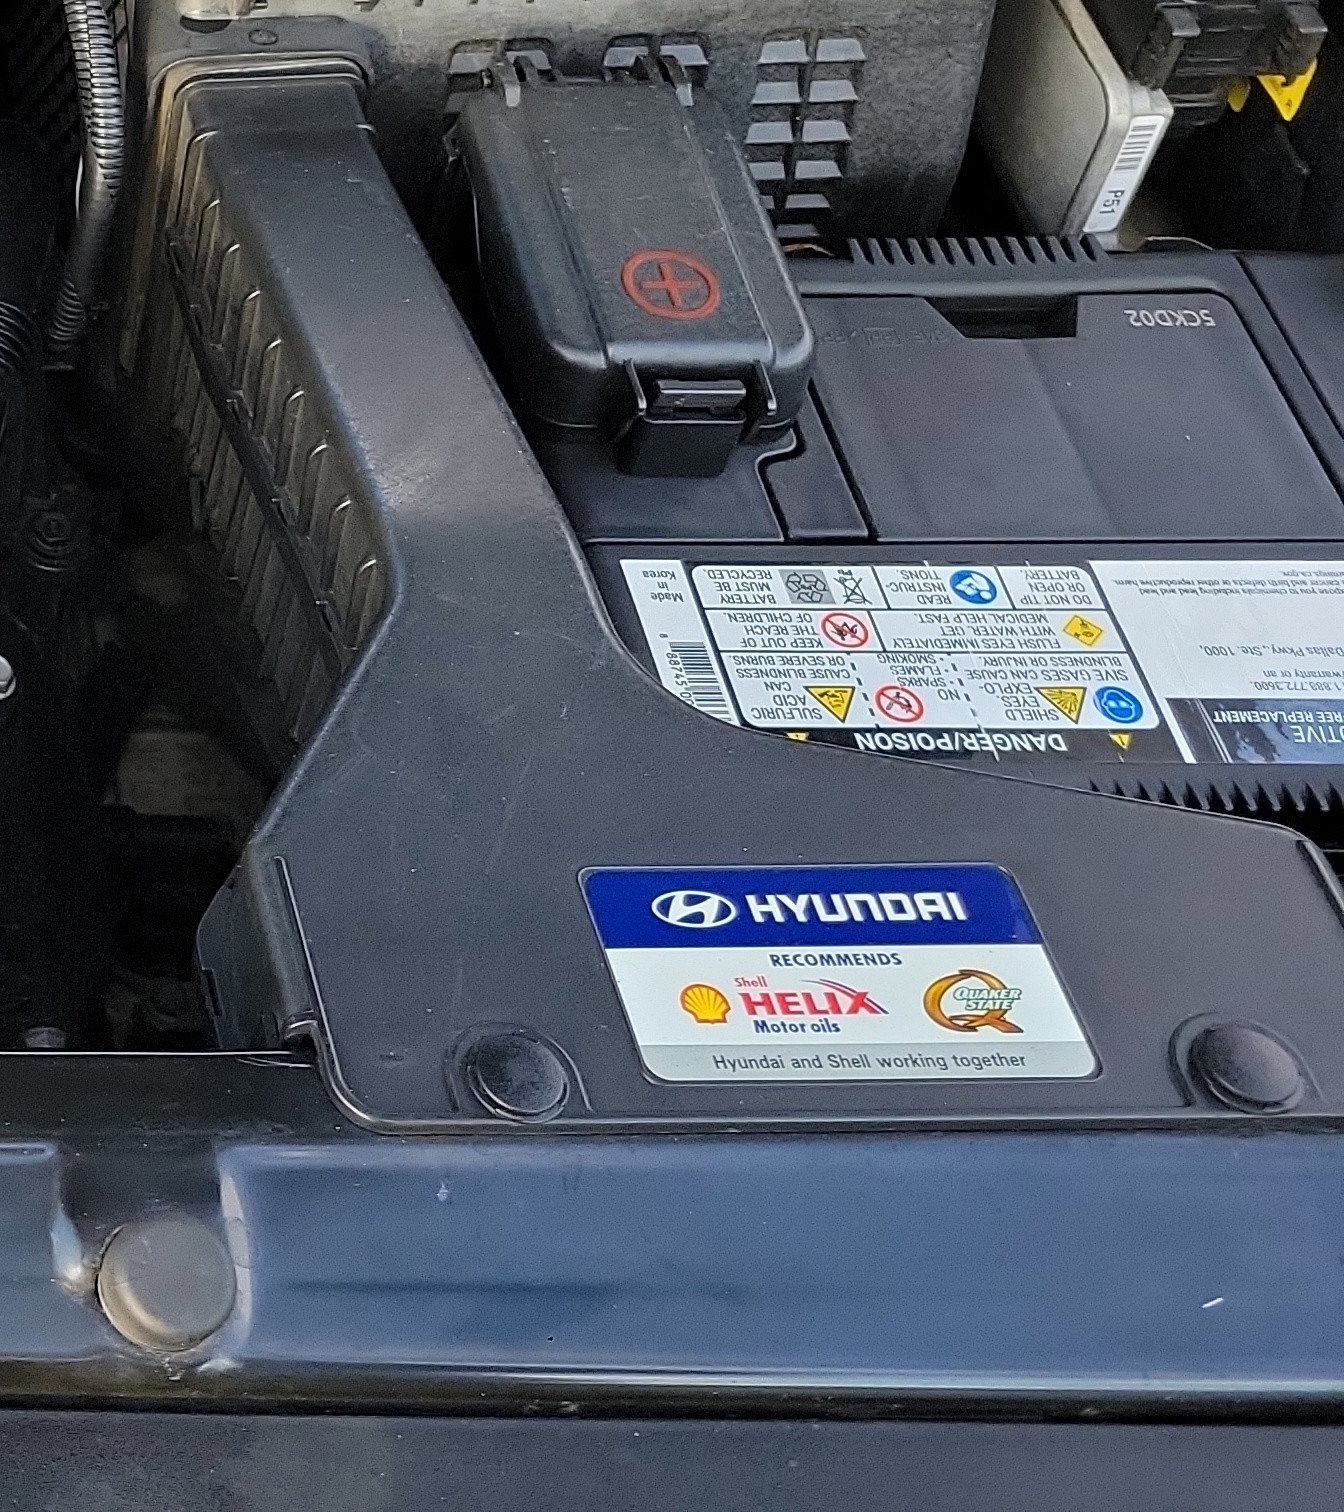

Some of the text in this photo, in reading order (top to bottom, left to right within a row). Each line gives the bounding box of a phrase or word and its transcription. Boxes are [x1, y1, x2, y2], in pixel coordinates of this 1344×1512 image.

[642, 570, 676, 580] Korea
[702, 569, 772, 580] RECYCLED.
[895, 569, 942, 580] TIONS.
[1019, 569, 1080, 580] BATTERY.
[657, 581, 668, 591] in
[713, 581, 771, 592] MUST BE
[885, 581, 947, 592] INSTRUC-
[1028, 582, 1086, 593] OR OPEN
[650, 592, 684, 603] Made
[719, 593, 776, 604] BATTERY
[916, 594, 952, 604] READ
[1019, 594, 1092, 605] DO NOT TIP
[722, 612, 812, 623] OF CHILDREN.
[913, 613, 1049, 623] MEDICAL HELP FAST.
[744, 625, 818, 636] THE REACH
[939, 626, 965, 636] GET
[1019, 626, 1055, 636] WITH
[739, 638, 823, 649] KEEP OUT OF
[892, 638, 1061, 649] FLUSH EYES IMMEDIATELY
[728, 655, 845, 666] OR SEVERE BURNS.
[876, 653, 936, 664] SMOKING
[978, 655, 1122, 666] BLINDNESS OR INJURY.
[735, 668, 851, 679] CAUSE BLINDNESS
[889, 665, 941, 675] FLAMES
[964, 669, 1129, 681] SIVE GASES CAN CAUSE
[764, 681, 791, 692] CAN
[897, 676, 946, 687] SPARKS
[978, 682, 1032, 694] EXPLO-
[937, 688, 960, 700] NO
[773, 694, 806, 707] ACID
[996, 695, 1040, 707] EYES.
[750, 707, 823, 720] SULFURIC
[1005, 708, 1059, 721] SHIELD
[1213, 710, 1344, 723] REE REPLACEMENT
[853, 732, 1068, 751] DANGER/POISON
[745, 892, 968, 923] HYUNDAI
[769, 952, 903, 967] RECOMMENDS
[734, 975, 768, 988] Shell
[953, 987, 1022, 1000] QUAKER
[738, 991, 883, 1016] HELIX
[964, 1000, 1014, 1011] STATE
[753, 1018, 842, 1034] Motor oils
[712, 1051, 1027, 1073] Hyundai and Shell working together
